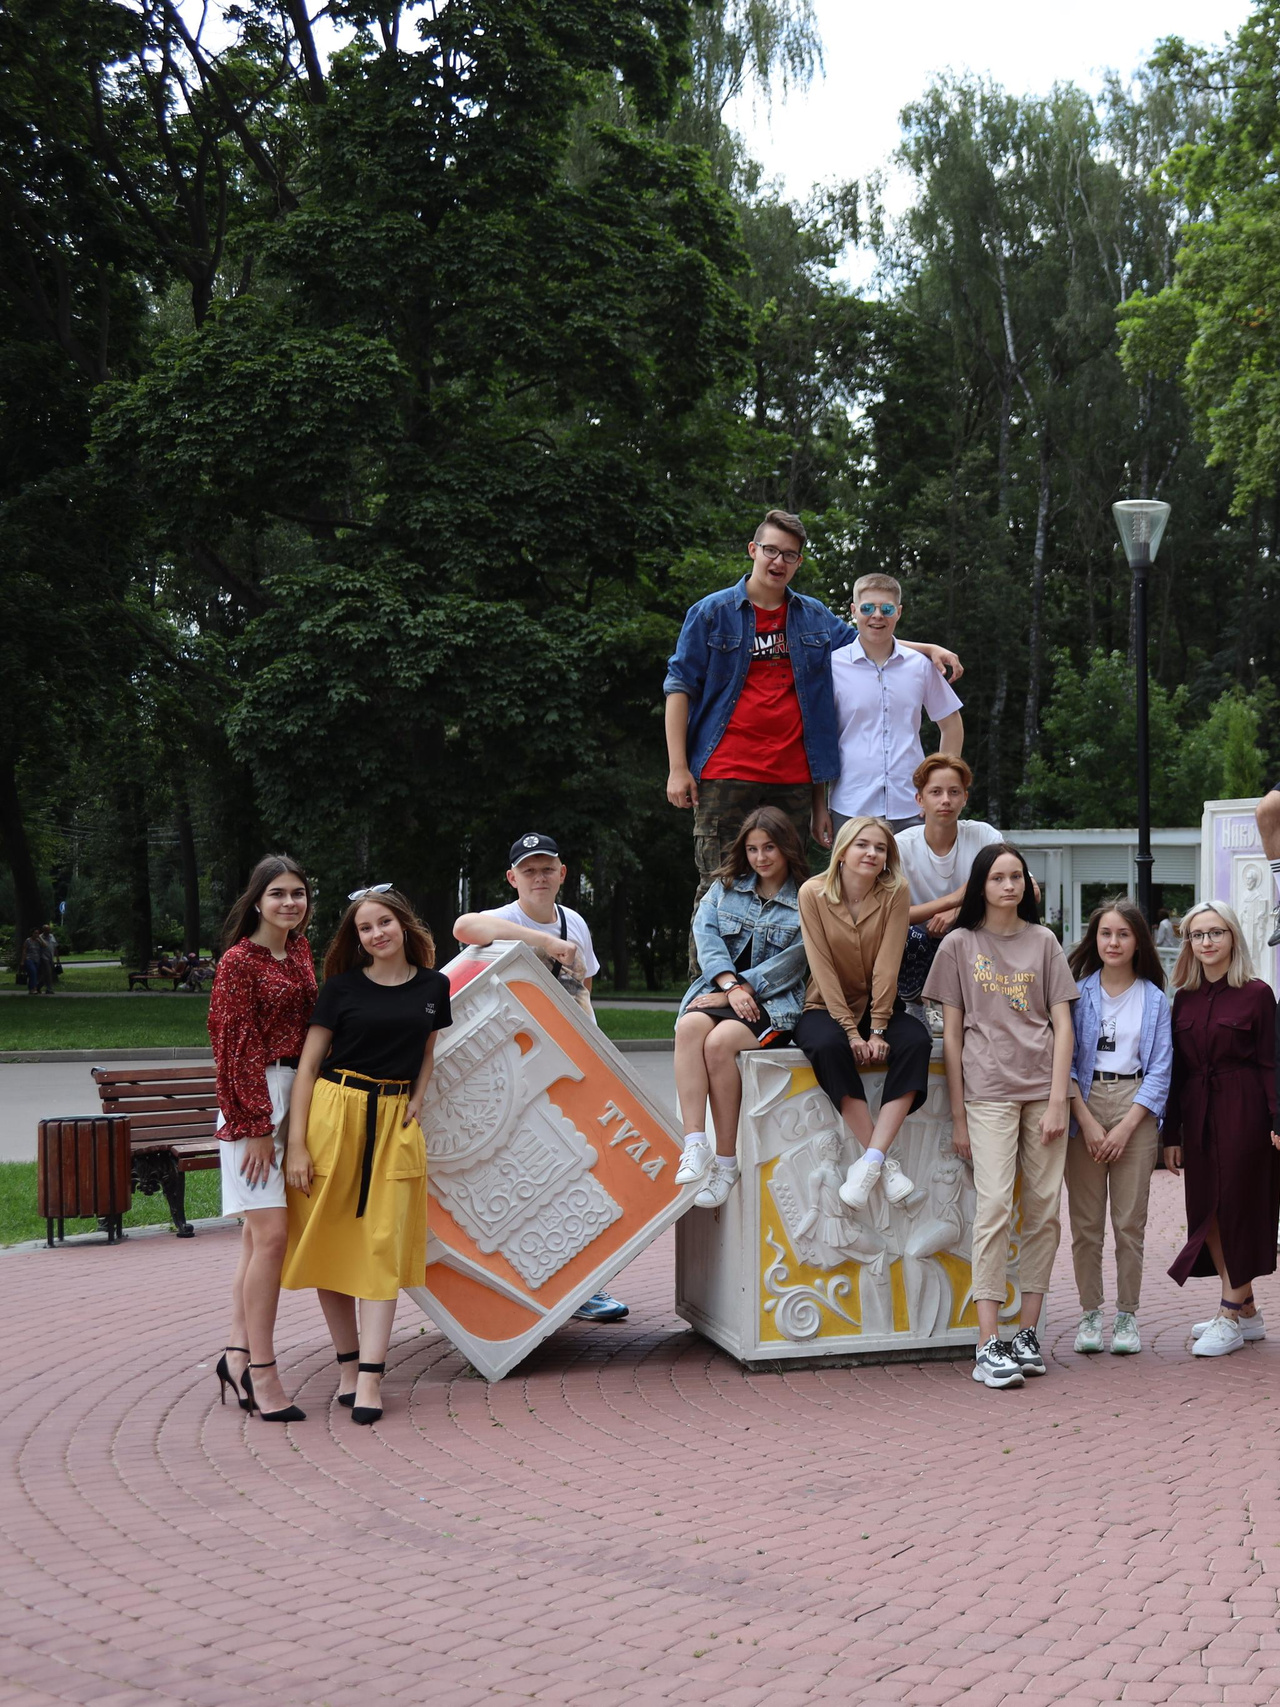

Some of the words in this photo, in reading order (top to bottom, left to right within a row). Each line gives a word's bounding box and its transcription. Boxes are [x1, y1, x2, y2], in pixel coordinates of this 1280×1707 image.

[973, 971, 993, 982] YOU
[1012, 973, 1036, 983] JUST
[597, 1099, 667, 1182] ТУЛА
